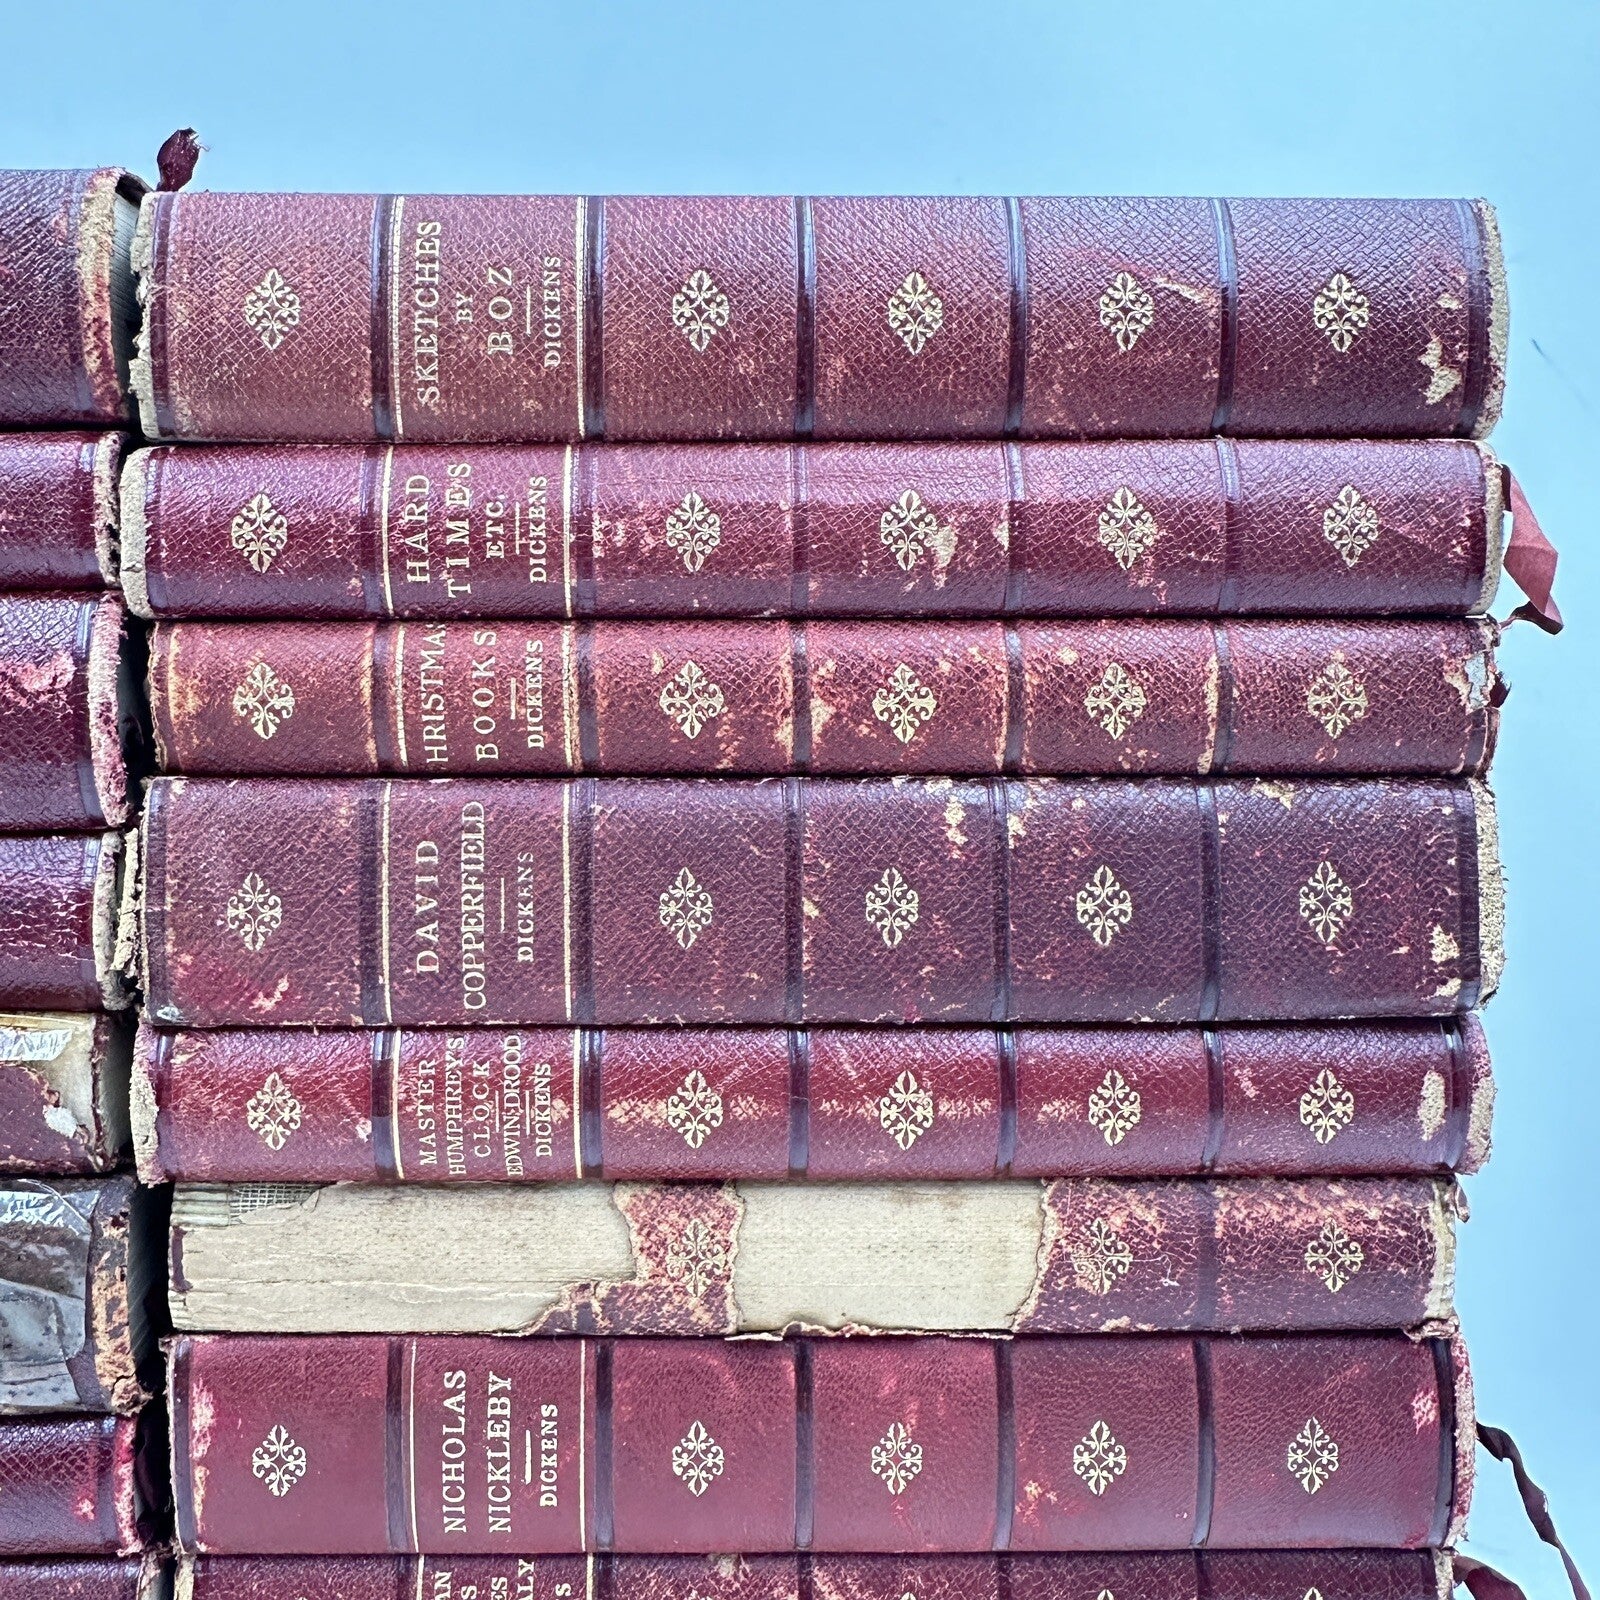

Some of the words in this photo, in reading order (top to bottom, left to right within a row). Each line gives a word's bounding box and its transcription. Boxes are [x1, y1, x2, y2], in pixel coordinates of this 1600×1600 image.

[415, 221, 441, 406] SKETCHES
[456, 292, 473, 323] BY
[488, 267, 513, 355] BOZ
[544, 256, 561, 368] DICKENS
[405, 475, 430, 583] HARD
[446, 463, 471, 598] TIMES
[529, 476, 548, 583] DICKENS
[420, 624, 448, 764] HRISTMA
[472, 630, 499, 761] BOOKS
[526, 639, 544, 750] DICKENS
[416, 841, 439, 973] DAVID
[461, 801, 486, 1009] COPPERFIELD
[517, 851, 534, 962] DICKENS
[418, 1058, 437, 1165] MASTER
[473, 1060, 491, 1157] CLOCK
[503, 1035, 522, 1109] DROOD
[534, 1063, 552, 1157] DICKENS
[442, 1369, 466, 1533] NICHOLAS
[487, 1371, 512, 1533] NICKLEBY
[540, 1404, 558, 1506] DICKENS
